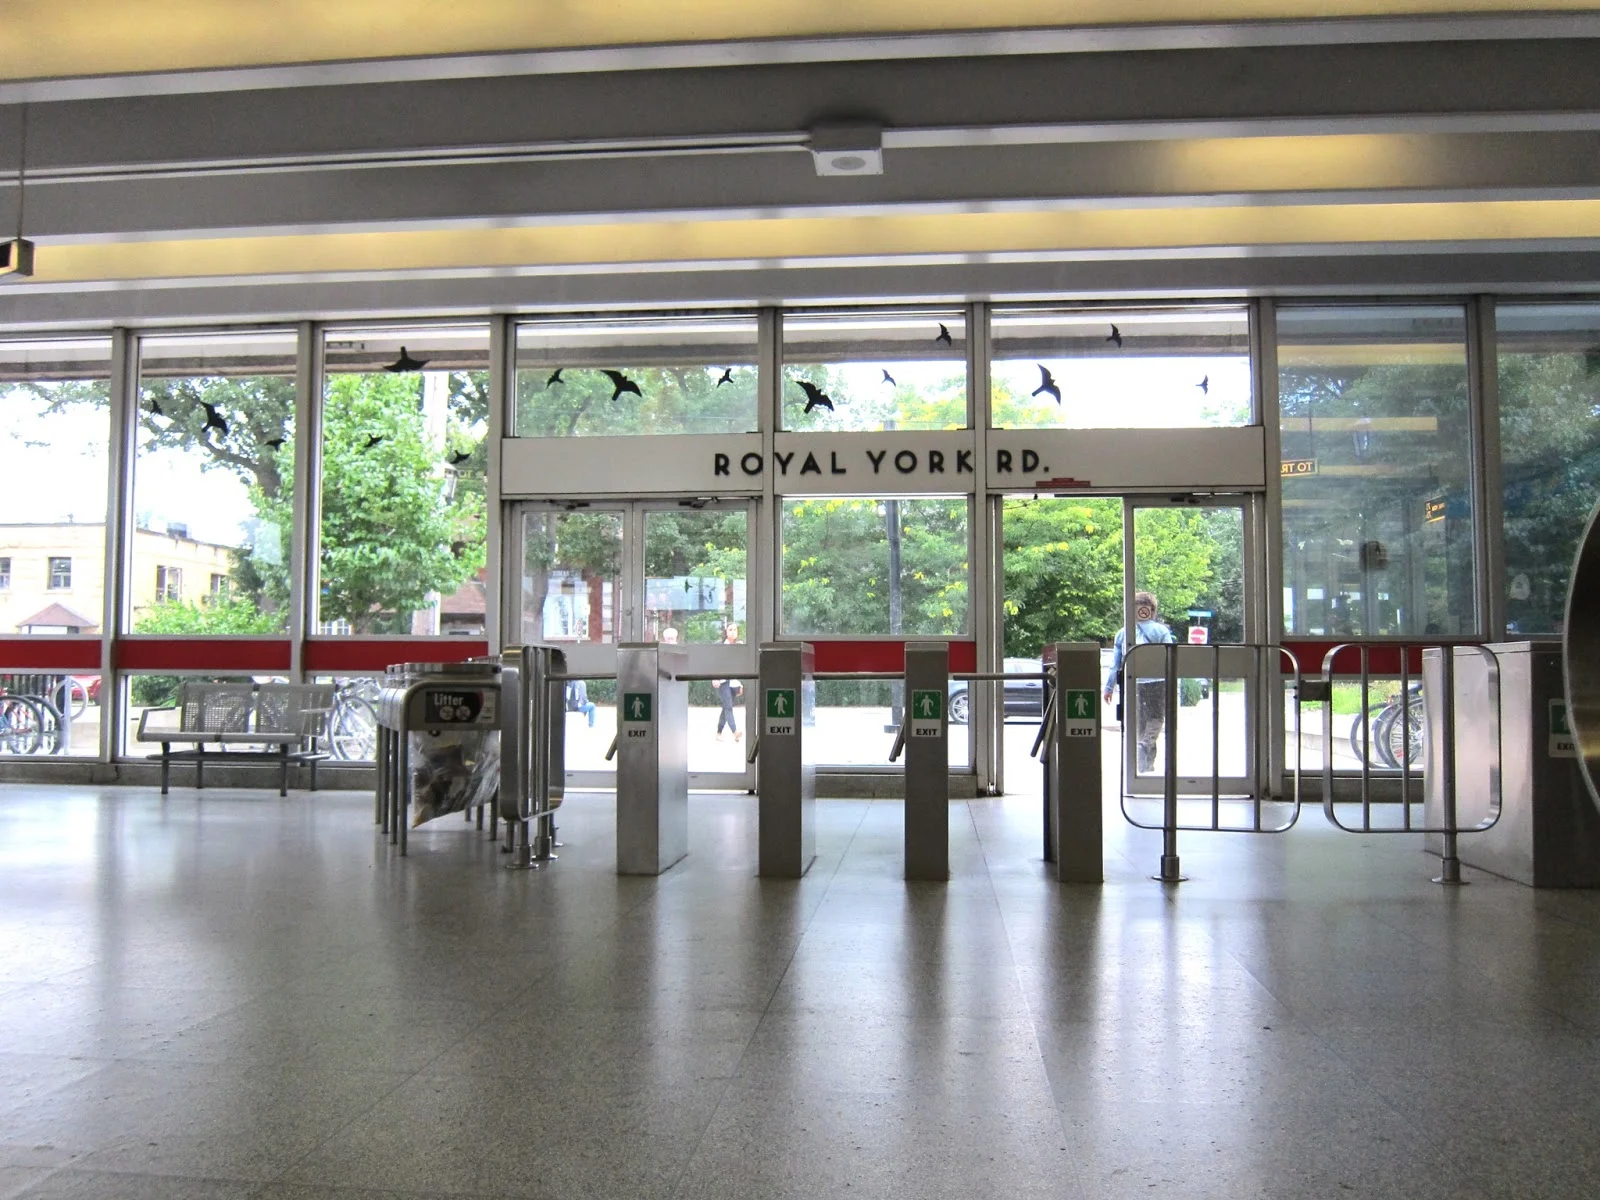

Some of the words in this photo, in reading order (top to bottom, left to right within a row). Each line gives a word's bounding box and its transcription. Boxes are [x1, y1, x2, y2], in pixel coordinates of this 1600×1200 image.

[714, 451, 847, 476] ROYAL
[866, 449, 974, 474] YORK
[996, 449, 1050, 473] RD.
[433, 692, 464, 706] Litter
[627, 730, 647, 738] EXIT
[769, 726, 792, 734] EXIT
[915, 728, 938, 736] EXIT
[1070, 728, 1093, 736] EXIT
